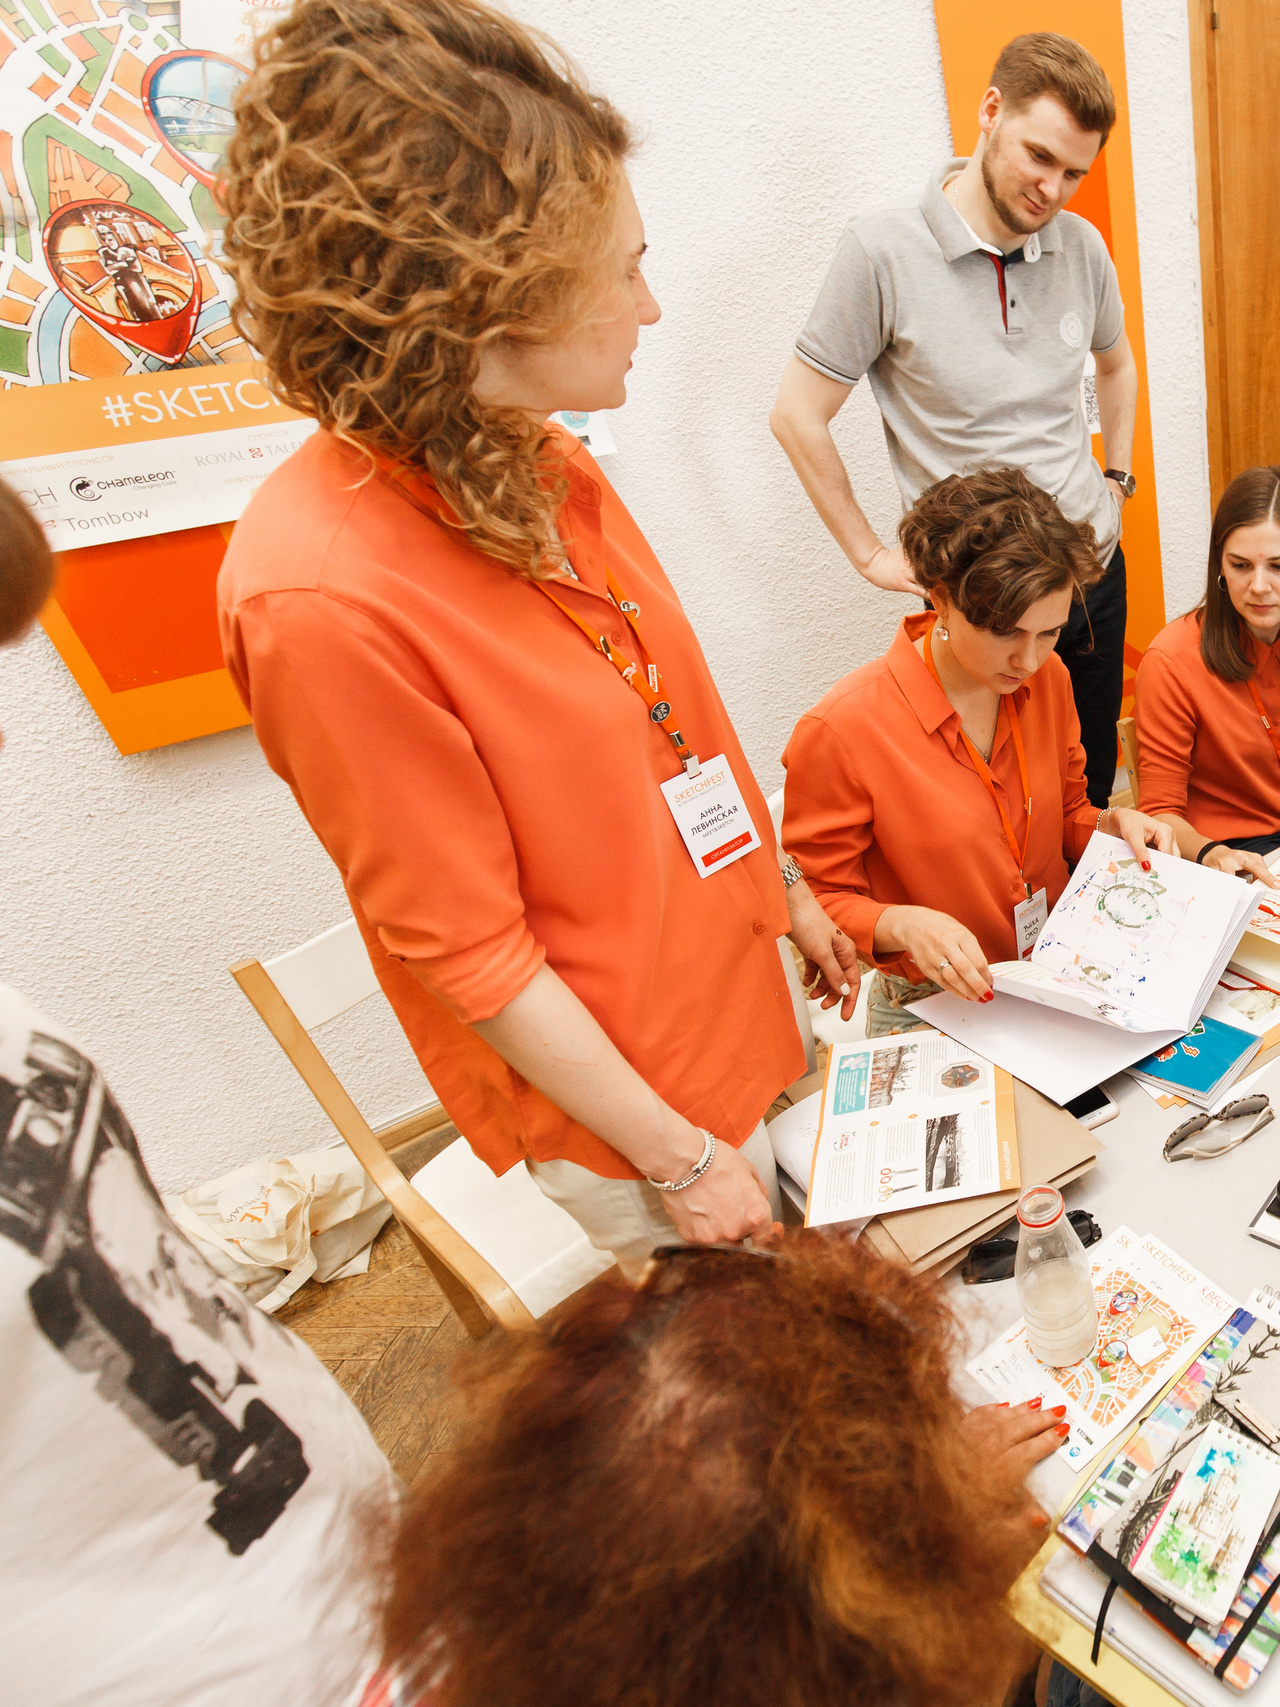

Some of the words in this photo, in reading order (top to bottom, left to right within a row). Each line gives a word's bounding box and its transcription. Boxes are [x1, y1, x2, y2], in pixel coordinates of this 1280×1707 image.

[195, 450, 248, 468] ROYAL
[62, 508, 149, 532] Tombow
[674, 771, 725, 803] SKETCHFEST
[691, 805, 738, 836] ЛЕВИНСКАЯ
[700, 803, 723, 820] АННА
[1142, 1241, 1198, 1285] SKETCHFEST
[1199, 1286, 1233, 1313] КВЕСТ
